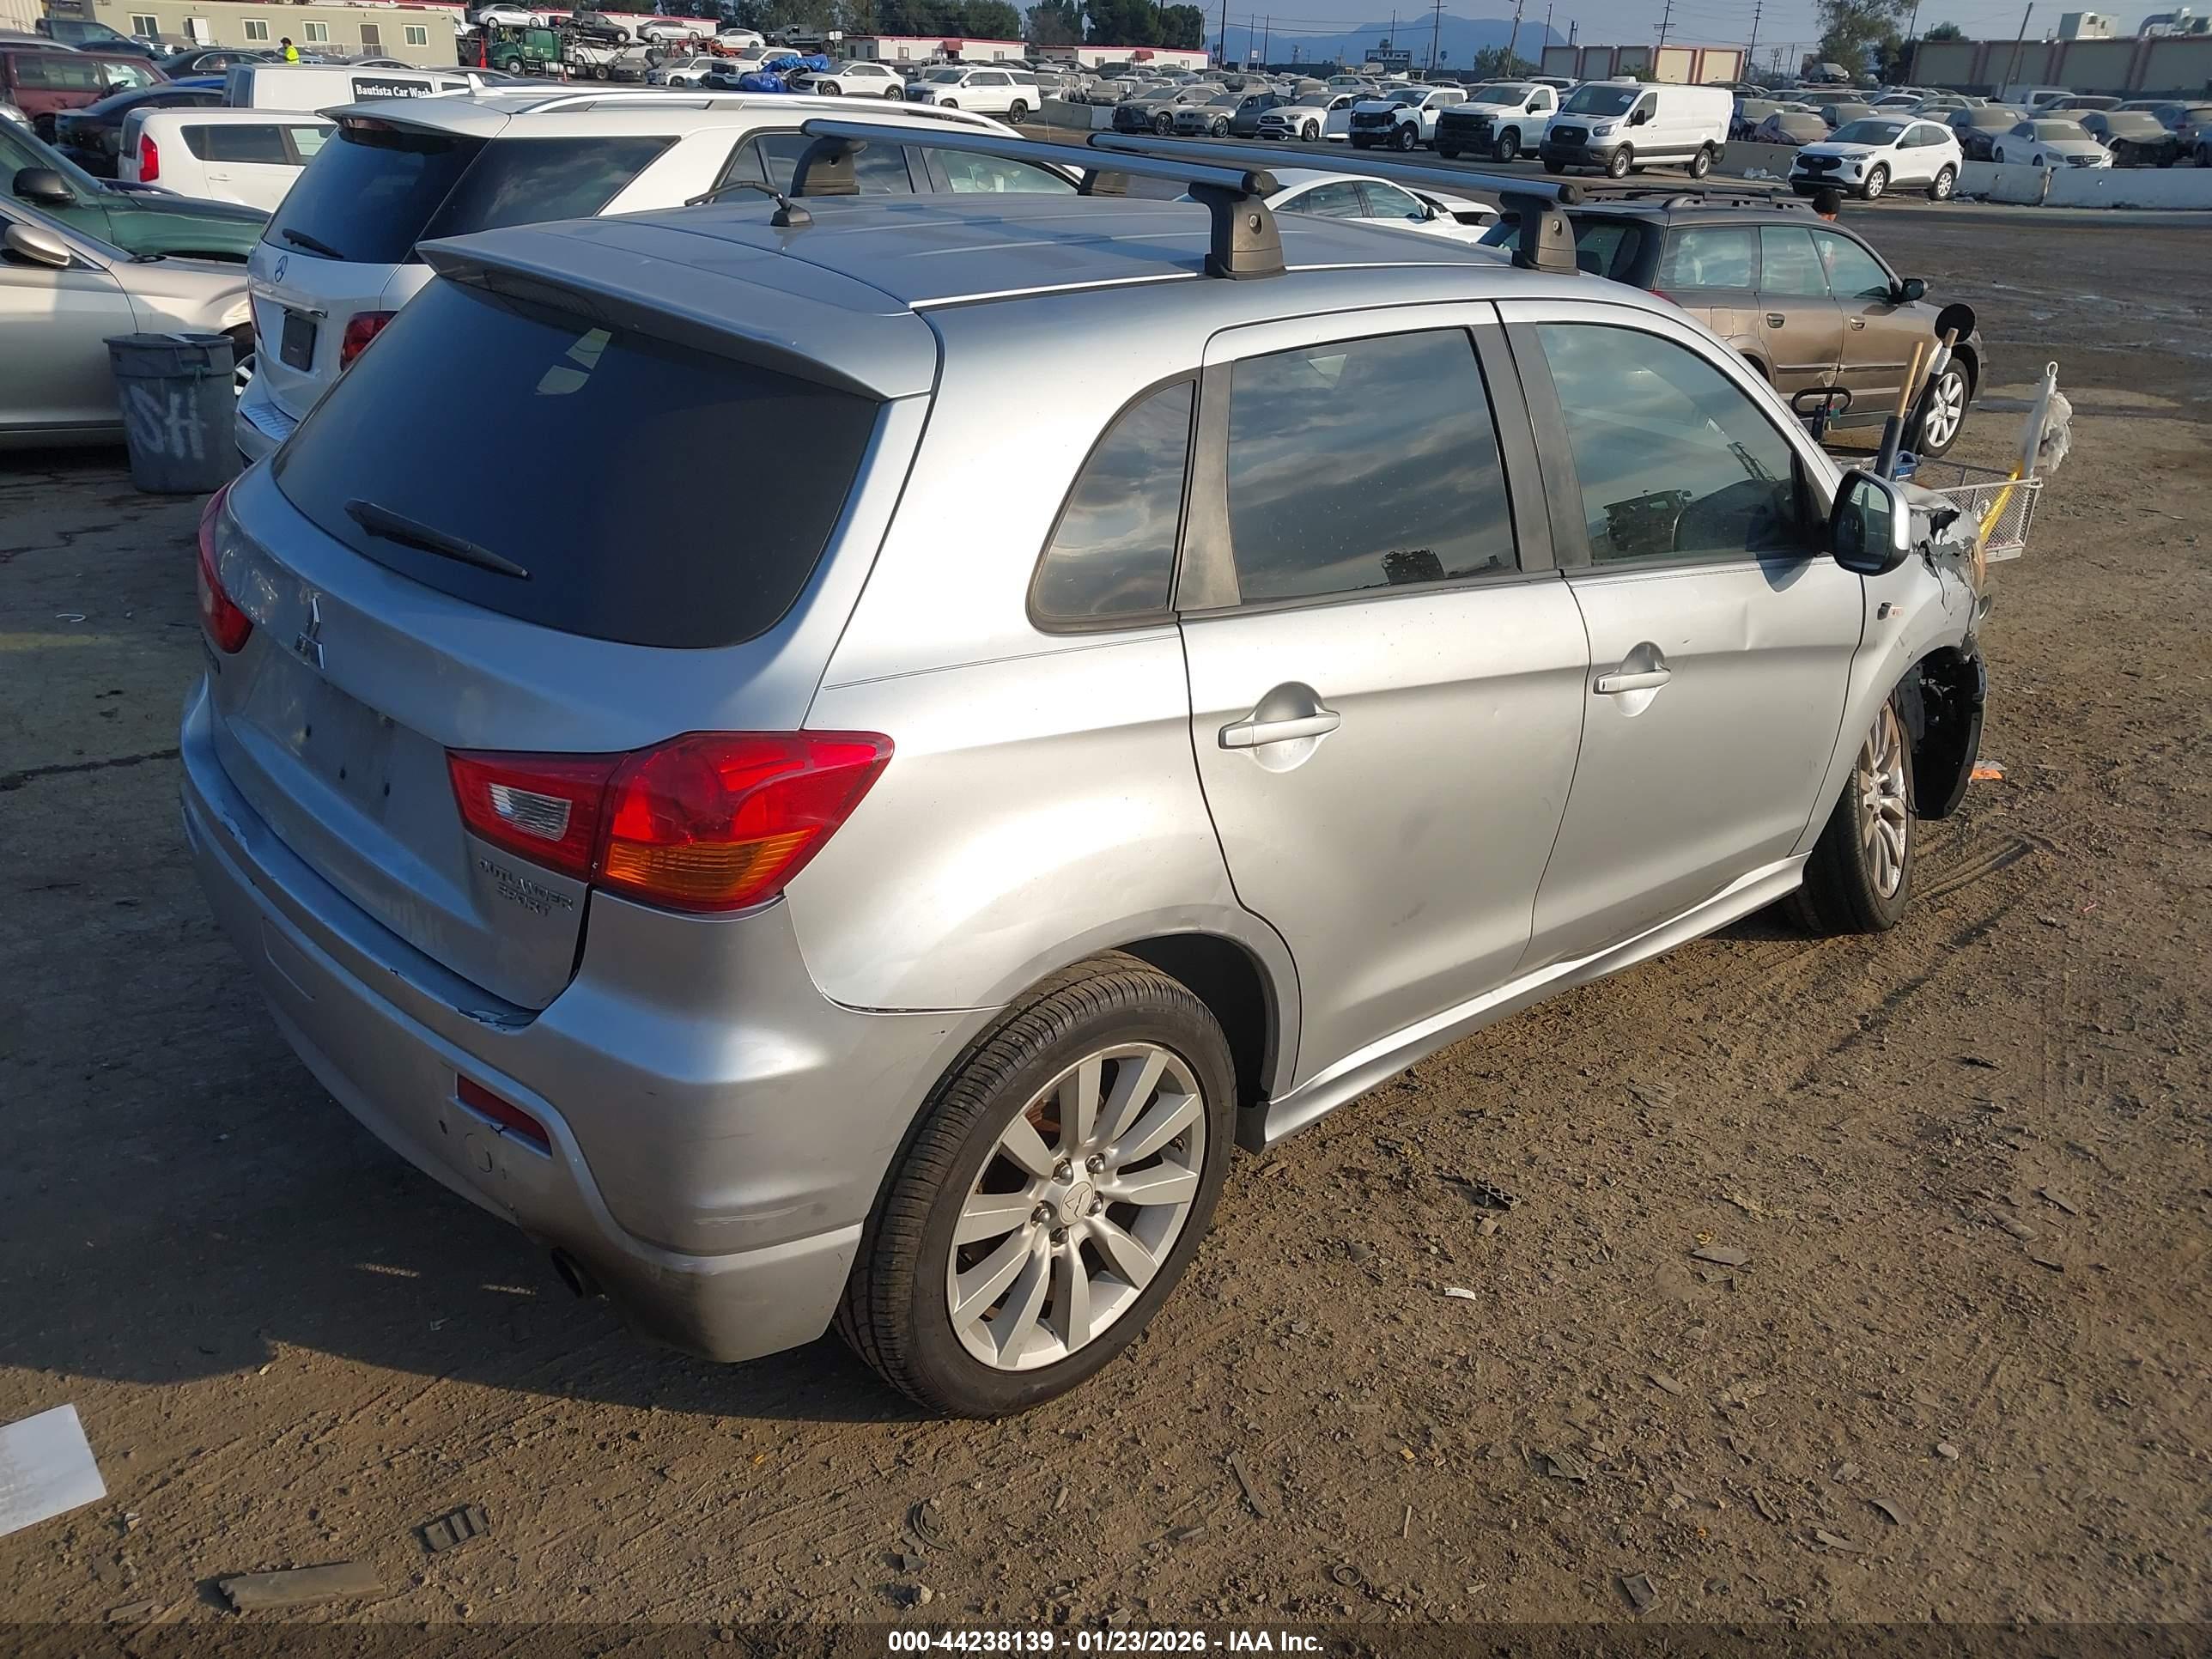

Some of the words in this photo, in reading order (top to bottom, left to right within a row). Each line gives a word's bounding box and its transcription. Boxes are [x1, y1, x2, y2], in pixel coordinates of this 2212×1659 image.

[356, 84, 392, 96] Bautista
[393, 87, 409, 96] Car
[478, 857, 574, 911] OUTLANDER
[497, 883, 551, 916] SPORT
